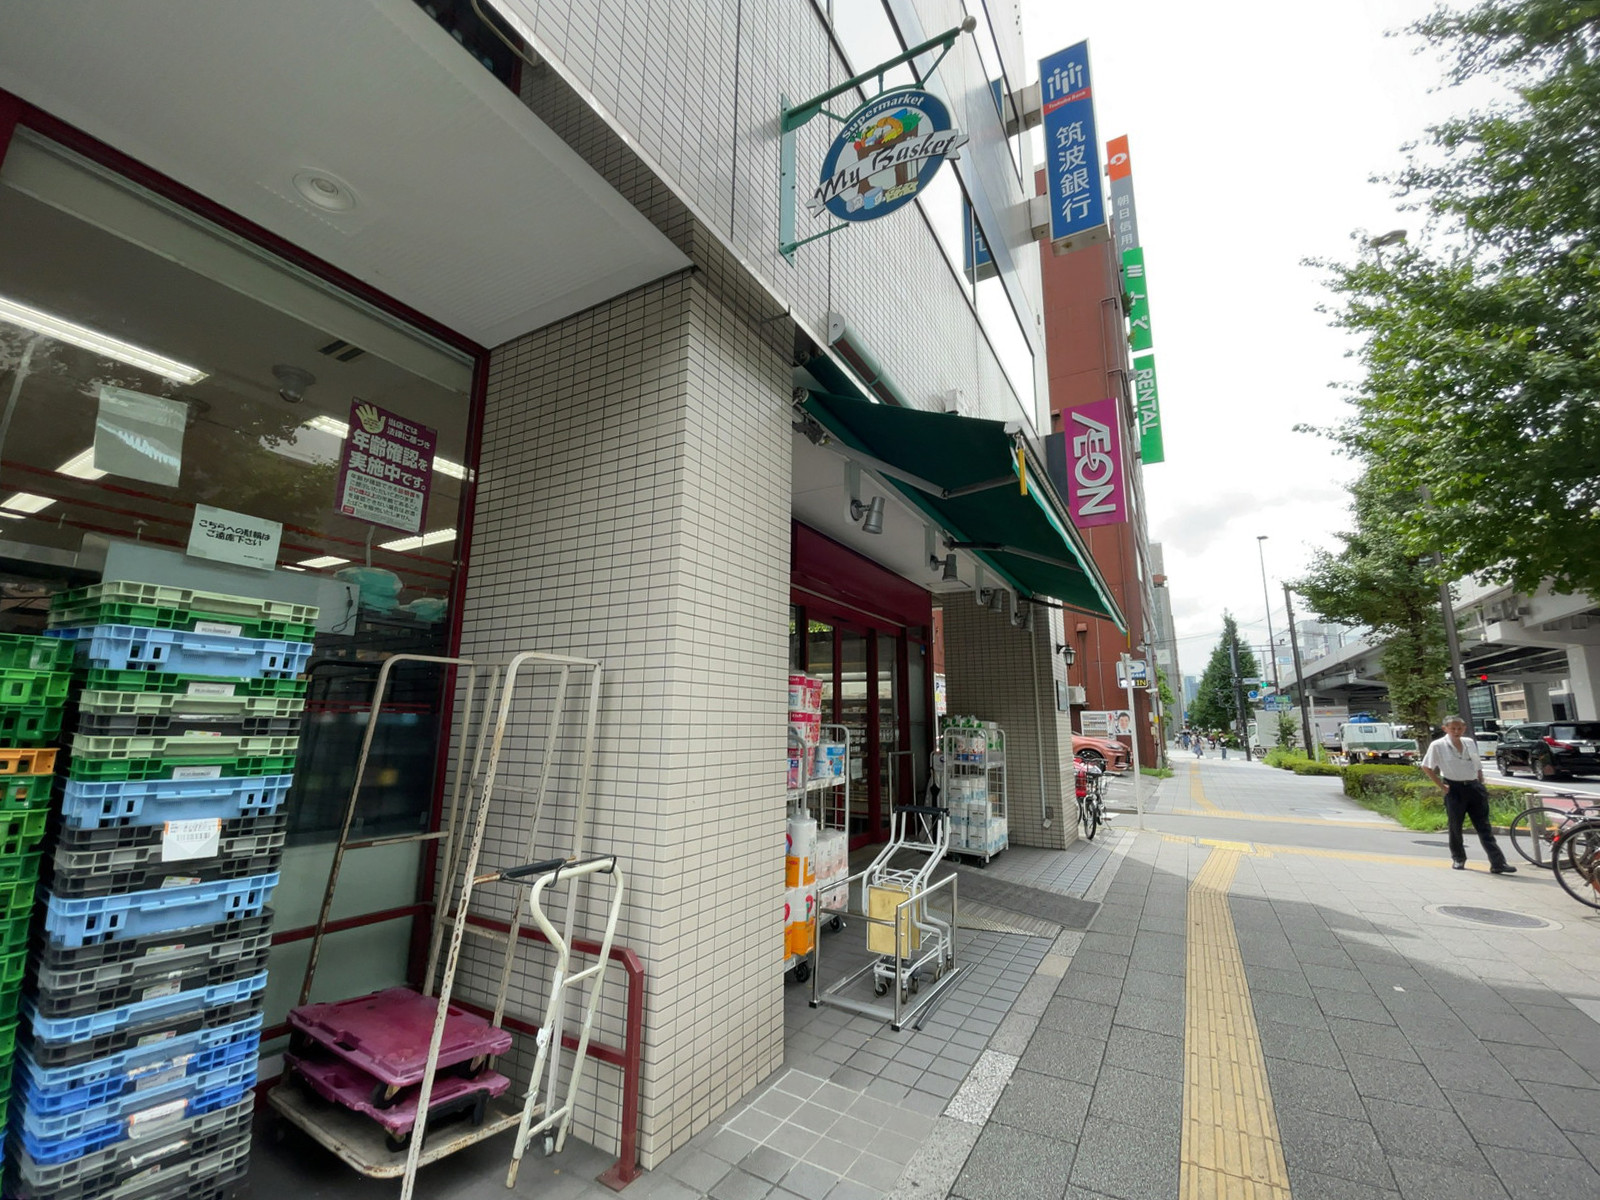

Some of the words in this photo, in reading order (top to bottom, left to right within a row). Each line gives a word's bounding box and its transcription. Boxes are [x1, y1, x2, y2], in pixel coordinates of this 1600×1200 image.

[842, 93, 924, 140] Supermarket
[814, 166, 861, 201] My
[872, 133, 957, 171] Basket
[1056, 121, 1092, 223] 筑波銀行
[1117, 194, 1133, 252] 朝日信用
[1137, 367, 1159, 435] RENTAL
[348, 450, 426, 491] 実施中です。
[352, 428, 428, 472] 年齢確認を
[1071, 411, 1117, 516] AEON
[198, 519, 271, 541] こちらへの駐輪は
[206, 529, 262, 546] ご遠慮下さい
